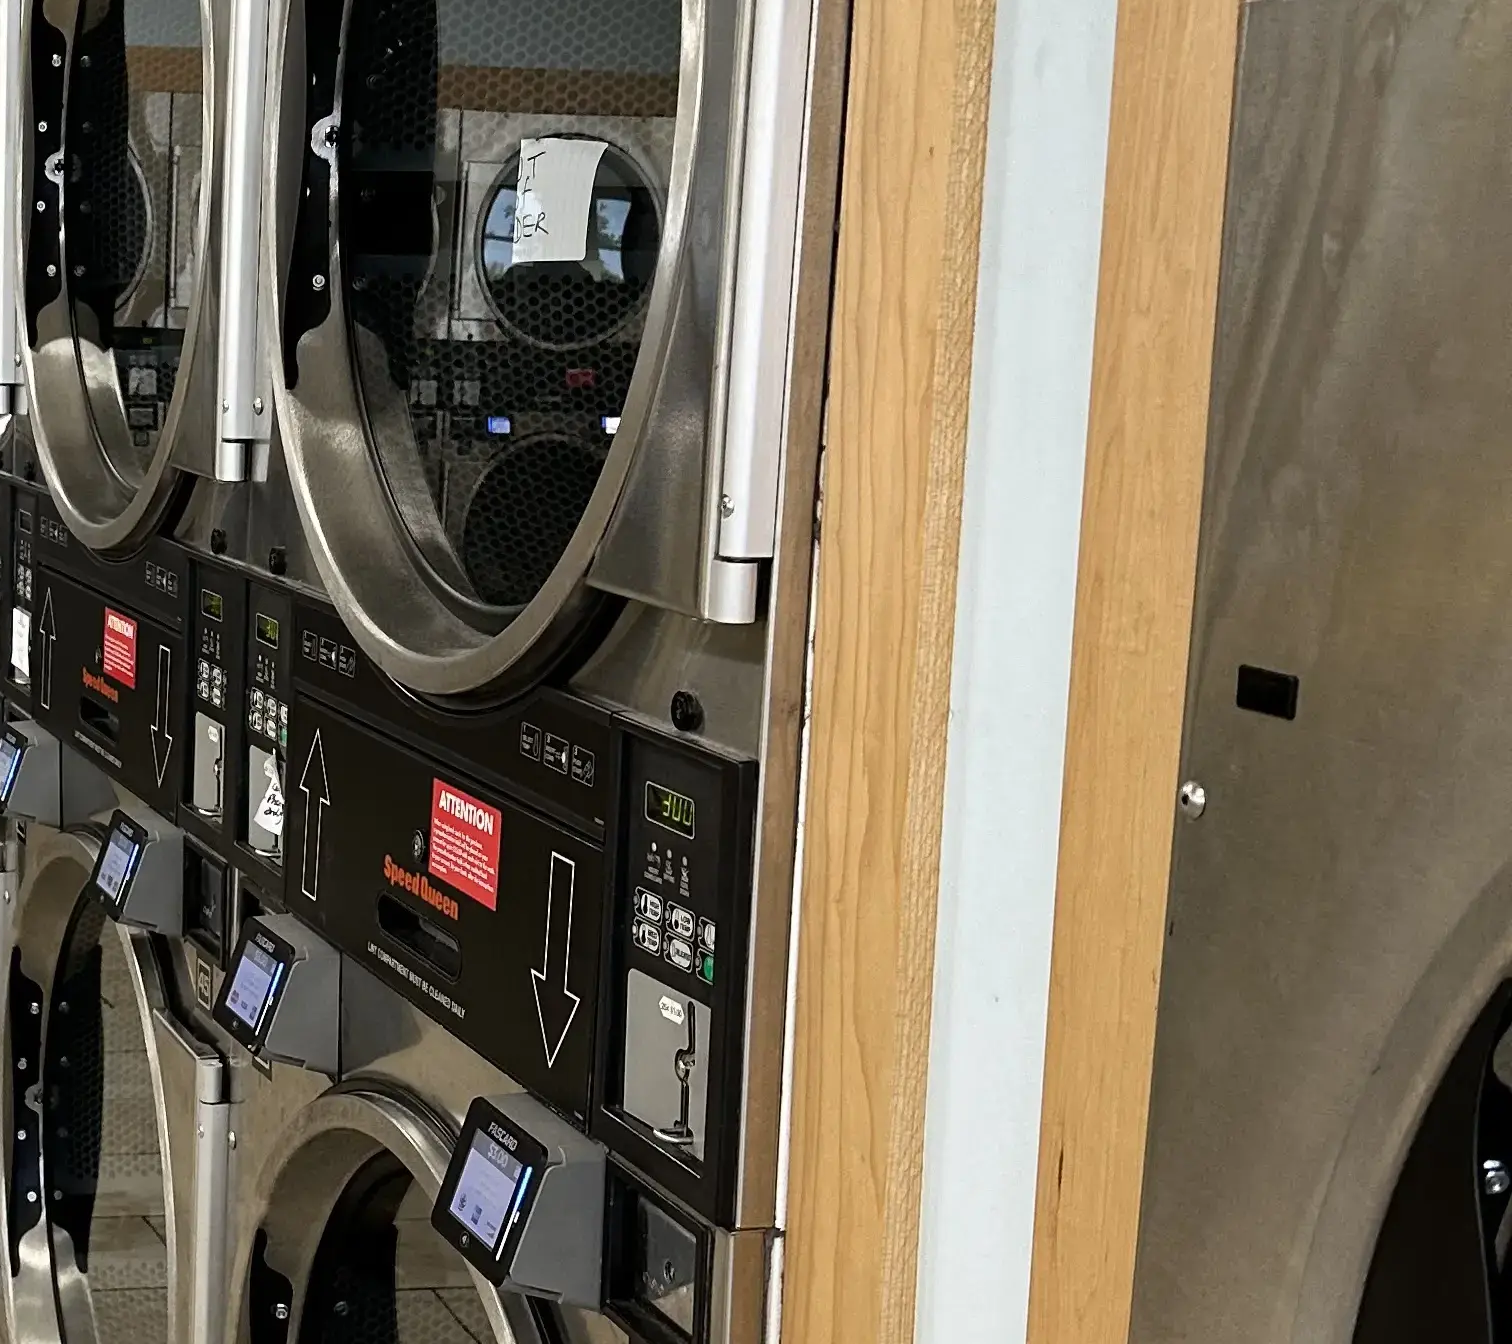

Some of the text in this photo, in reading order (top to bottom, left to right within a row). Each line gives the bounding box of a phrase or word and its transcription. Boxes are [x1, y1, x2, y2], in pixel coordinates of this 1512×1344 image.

[438, 789, 494, 836] ATTENTION
[383, 854, 420, 897] Speed
[420, 875, 459, 921] Queen
[488, 1121, 518, 1152] FASCARD
